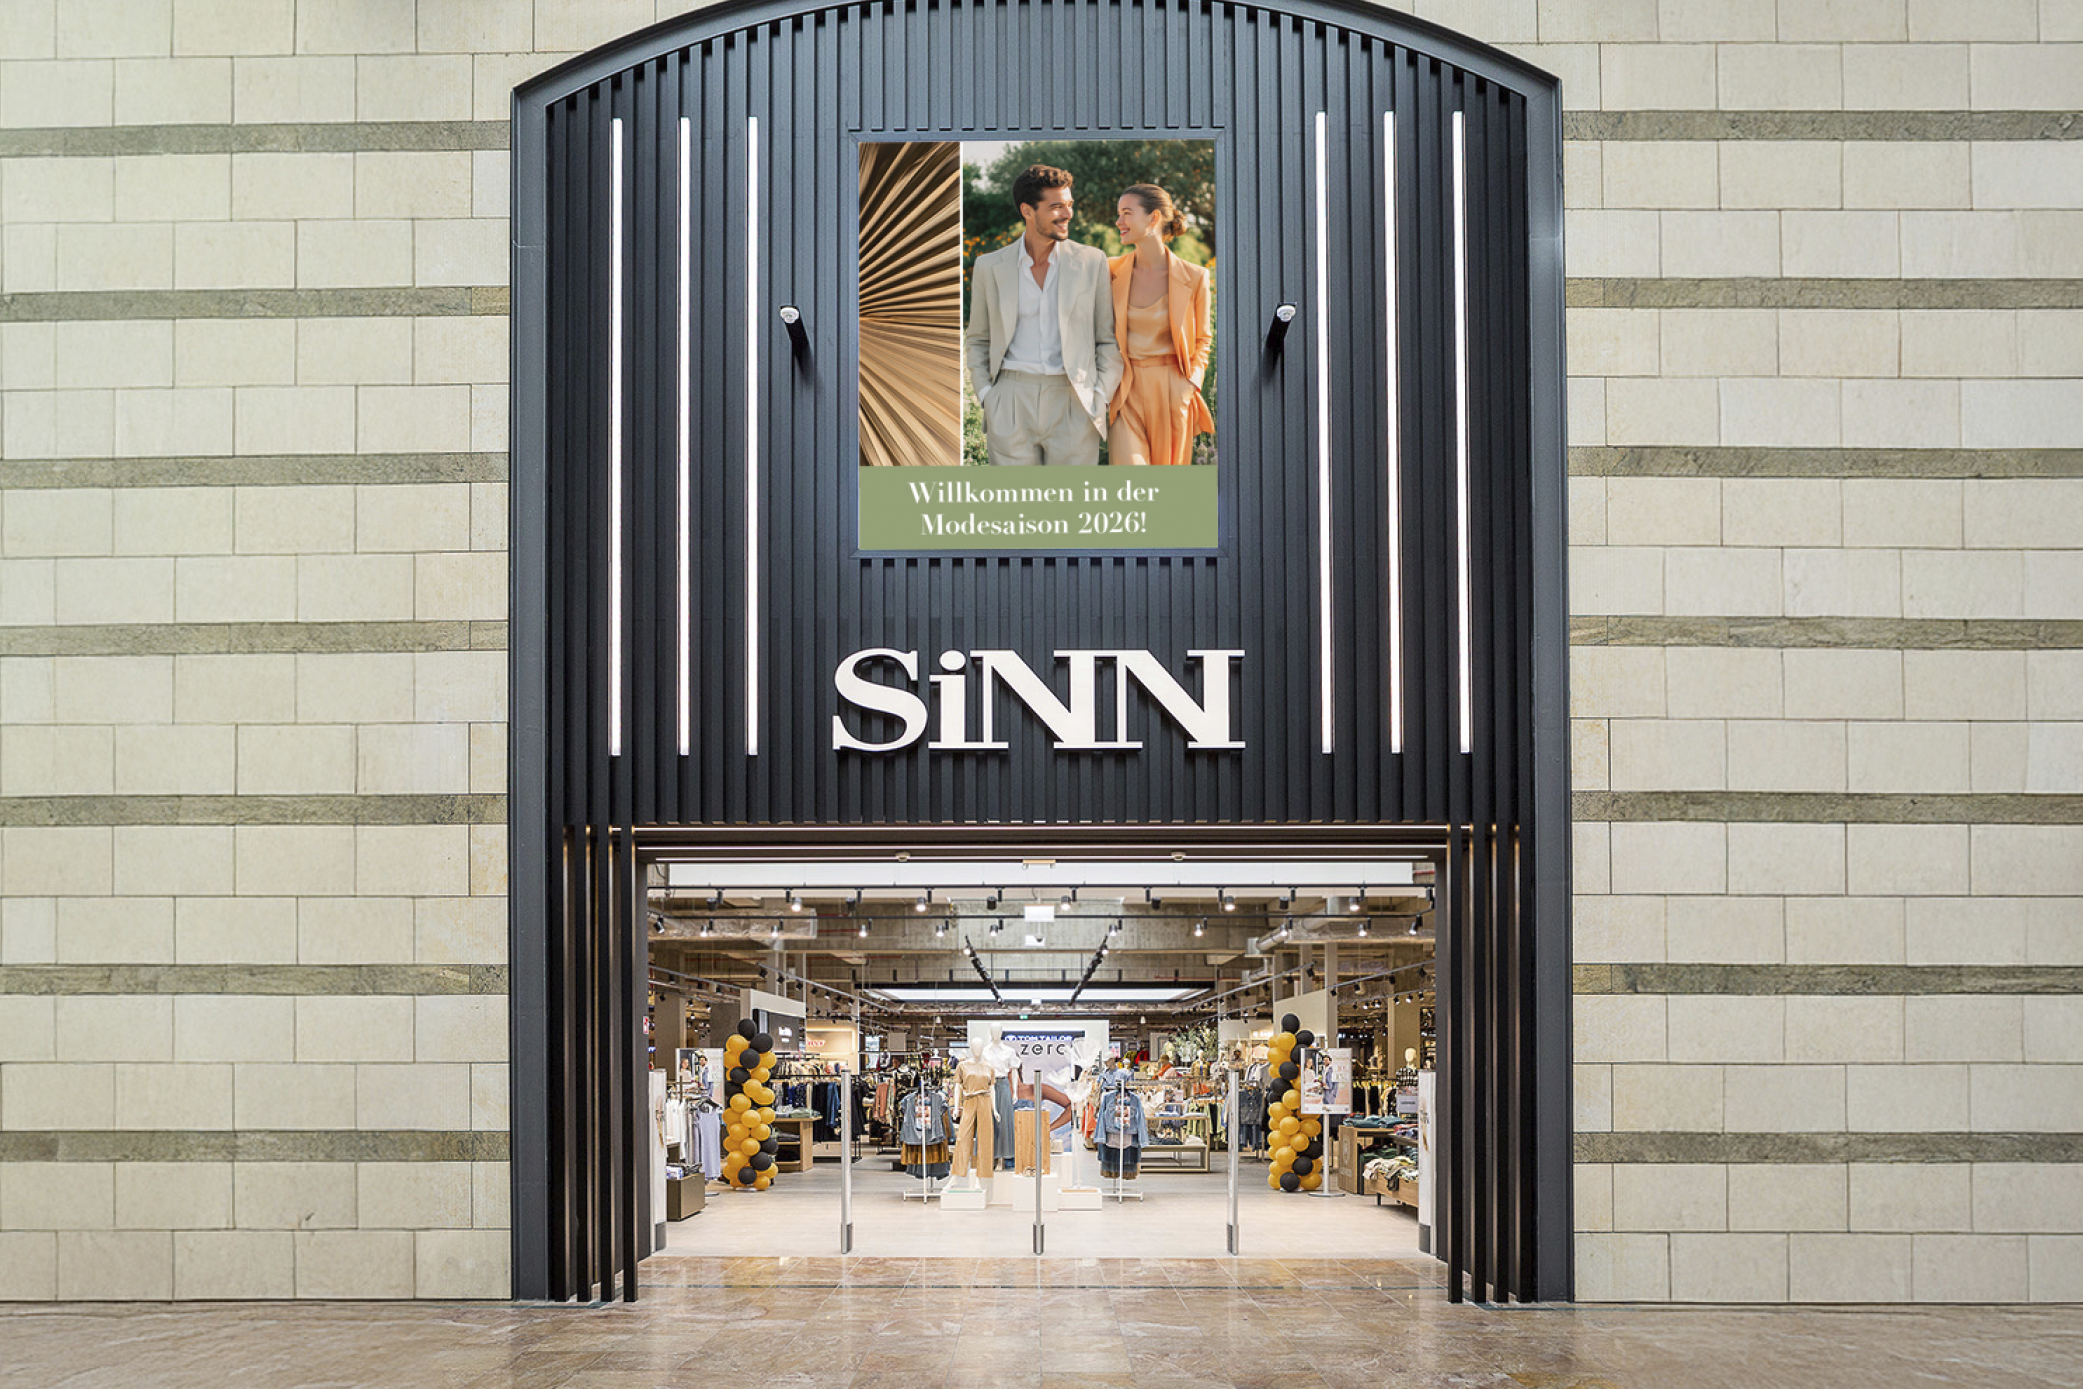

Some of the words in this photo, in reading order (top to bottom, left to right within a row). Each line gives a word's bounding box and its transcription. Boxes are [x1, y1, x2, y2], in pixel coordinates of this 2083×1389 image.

[908, 481, 1073, 504] Willkommen
[1084, 480, 1107, 502] in
[1116, 479, 1160, 502] der
[921, 513, 1069, 535] Modesaison
[1078, 511, 1147, 533] 2026!
[832, 648, 1246, 752] SiNN
